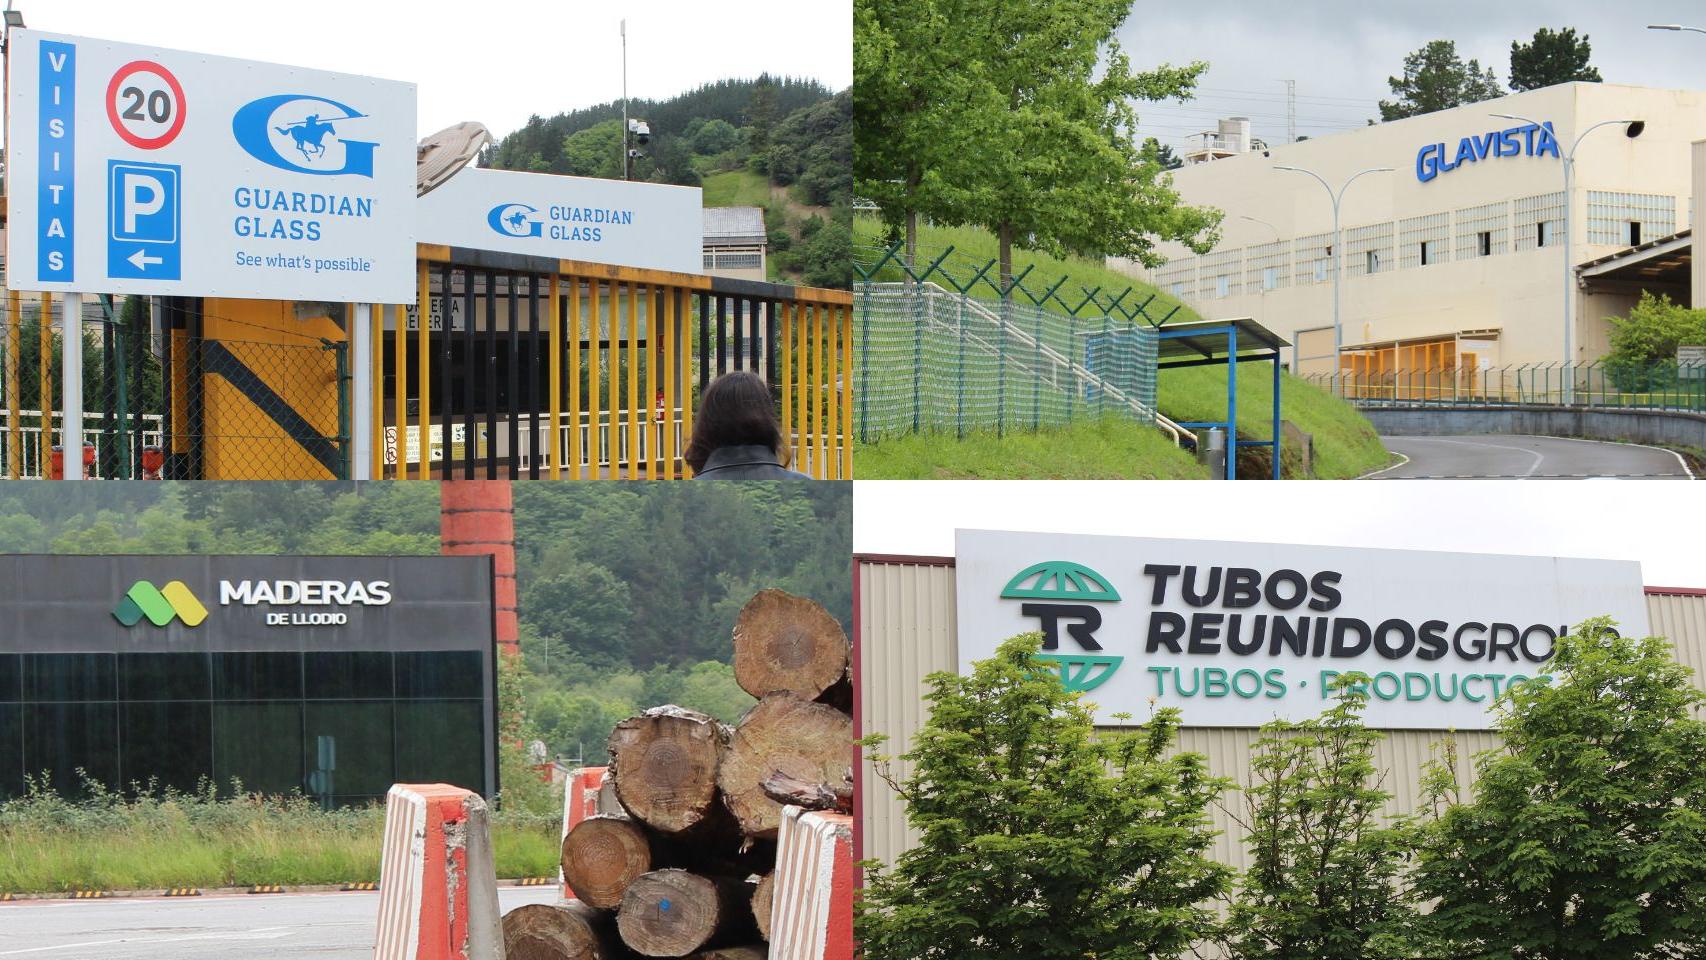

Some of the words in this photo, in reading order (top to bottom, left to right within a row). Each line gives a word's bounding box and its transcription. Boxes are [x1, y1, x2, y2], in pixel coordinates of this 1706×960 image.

[122, 86, 171, 123] 20
[47, 52, 67, 271] VISITAS
[1416, 121, 1560, 182] GLAVISTA
[124, 173, 165, 233] P
[234, 187, 372, 218] GUARDIAN
[550, 206, 632, 224] GUARDIAN
[234, 216, 321, 241] GLASS
[550, 225, 602, 242] GLASS
[236, 251, 262, 266] See
[266, 253, 311, 269] what's
[315, 257, 371, 273] possible
[219, 580, 392, 606] MADERAS
[1144, 564, 1342, 611] TUBOS
[266, 612, 289, 625] DE
[292, 612, 347, 626] LLODIO
[1021, 603, 1104, 651] TR
[1148, 666, 1287, 699] TUBOS
